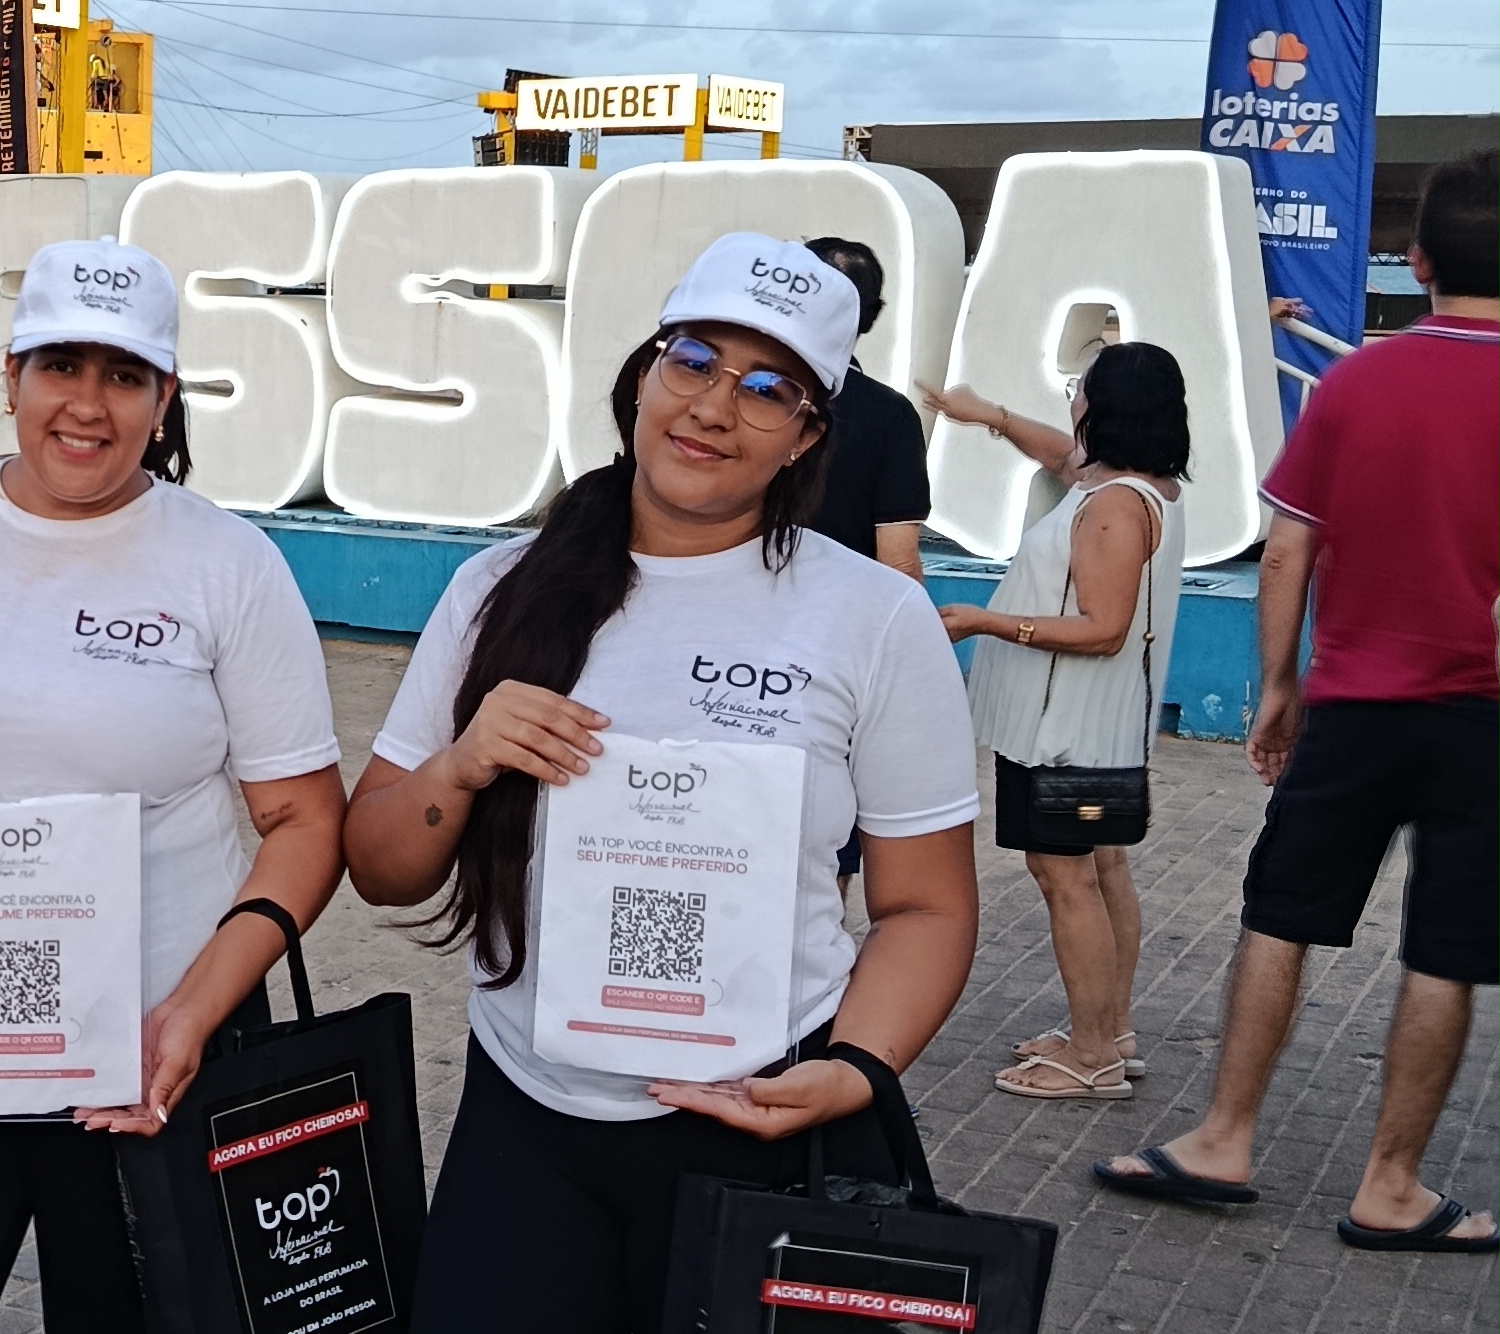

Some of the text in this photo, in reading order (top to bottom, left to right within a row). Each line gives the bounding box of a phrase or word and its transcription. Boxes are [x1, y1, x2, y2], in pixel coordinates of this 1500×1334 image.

[0, 56, 16, 173] RETENIMENTO
[533, 84, 681, 120] VAIDEBET
[717, 85, 777, 122] VAIDEBET
[1211, 88, 1340, 122] loterias
[1208, 118, 1336, 154] CAIXA
[1290, 190, 1308, 199] DO
[1255, 201, 1338, 239] ASIL
[1281, 240, 1330, 251] BRASILEIRO
[74, 263, 131, 291] top
[751, 257, 810, 294] top
[75, 609, 164, 648] top
[691, 655, 792, 700] top
[628, 764, 695, 798] top
[577, 849, 748, 875] SEU PERFUME PREFERIDO
[578, 835, 748, 859] NA TOP VOCÊ ENCONTRA O
[19, 894, 82, 906] ENCONTRA
[85, 894, 95, 905] O
[26, 908, 95, 919] PREFERIDO
[213, 1104, 365, 1165] AGORA EU FICO CHEIROSA!
[255, 1183, 330, 1229] top
[263, 1258, 369, 1306] A LOJA MAIS PERFUMADA
[300, 1285, 344, 1308] DO BRASIL
[306, 1321, 320, 1333] EM
[320, 1311, 344, 1327] JOÃO
[344, 1298, 377, 1317] PESSOA
[769, 1284, 970, 1322] AGORA EU FICO CHEIROSA!
